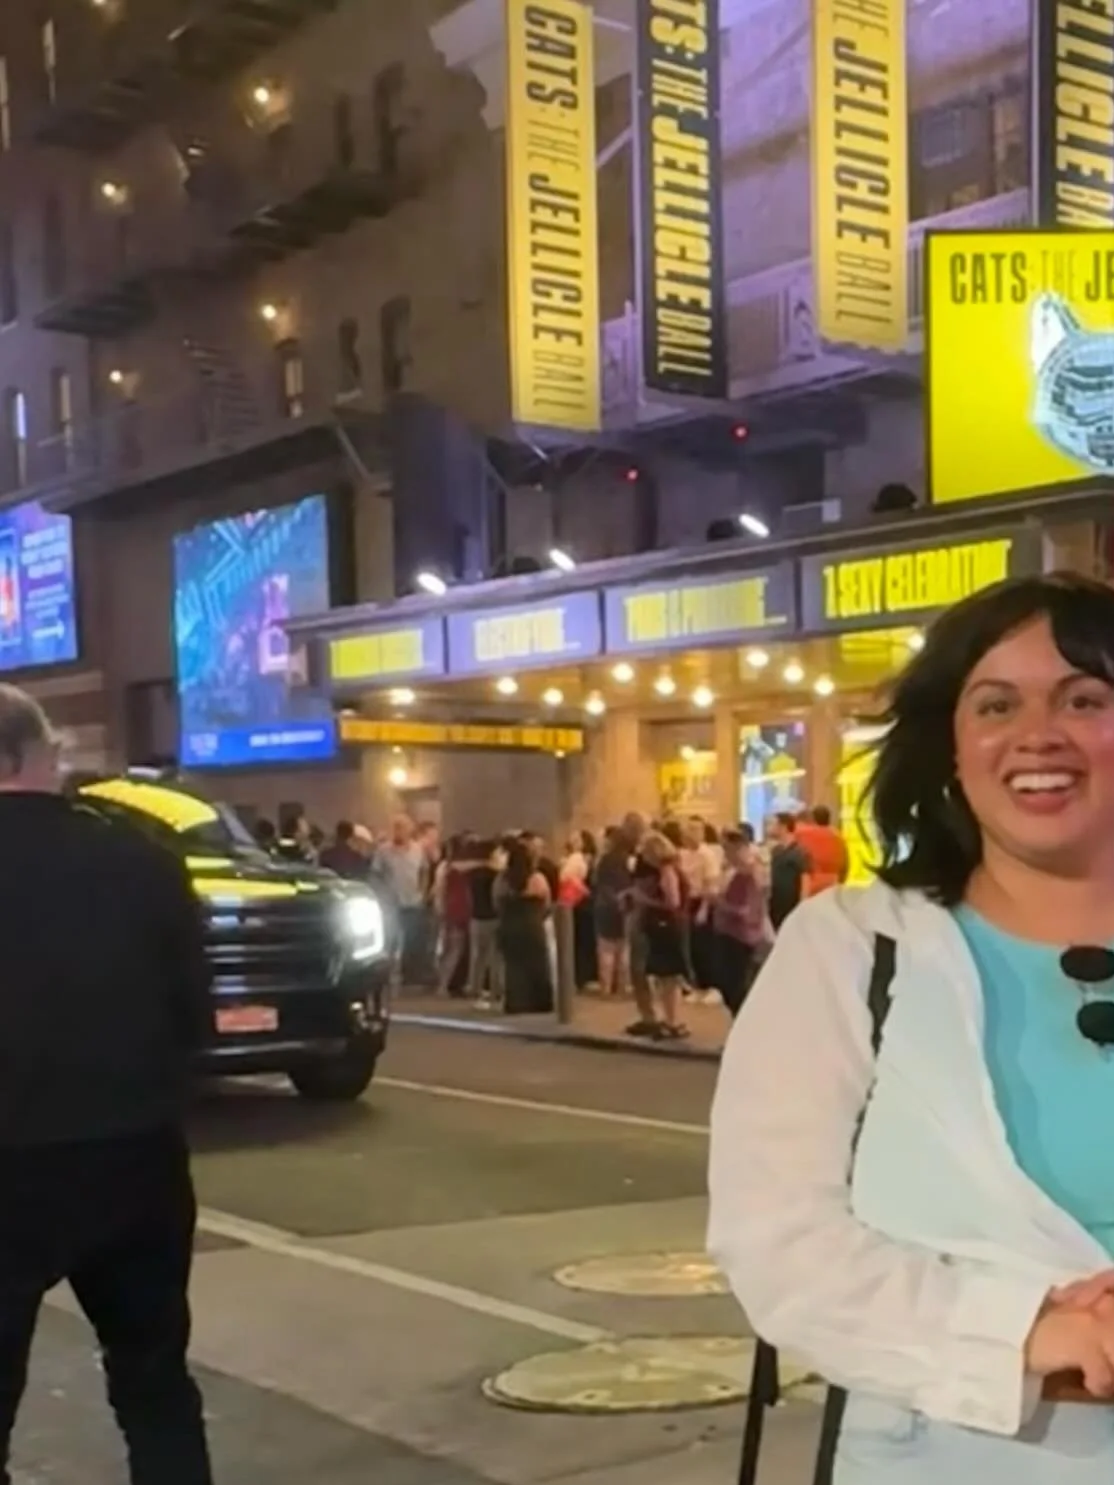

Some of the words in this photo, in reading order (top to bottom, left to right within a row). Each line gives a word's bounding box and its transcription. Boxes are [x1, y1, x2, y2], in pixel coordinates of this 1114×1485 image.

[832, 0, 889, 37] HE
[652, 58, 708, 120] THE
[527, 118, 580, 172] THE
[833, 37, 890, 250] JELLICLE
[651, 114, 712, 309] JELLICLE
[528, 172, 583, 347] JELLICLE
[835, 250, 892, 324] BALL
[656, 308, 712, 377] BALL
[532, 349, 586, 410] BALL
